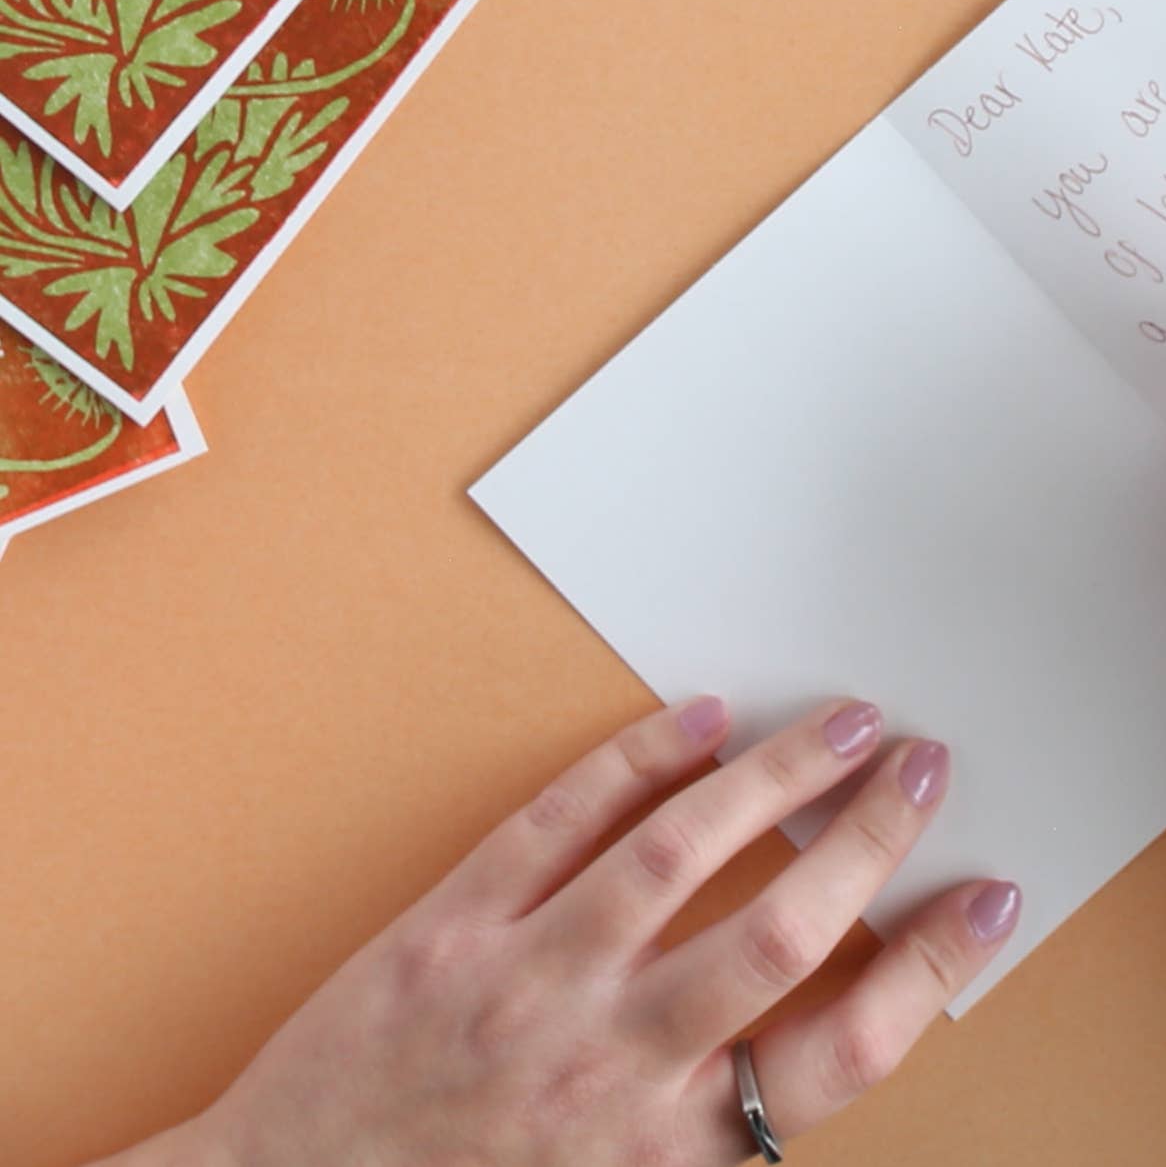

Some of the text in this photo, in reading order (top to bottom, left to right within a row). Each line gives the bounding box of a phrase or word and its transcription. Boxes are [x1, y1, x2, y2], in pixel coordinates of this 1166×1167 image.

[927, 7, 1123, 157] Dear Kate,
[1032, 152, 1108, 237] you
[1104, 240, 1164, 284] of
